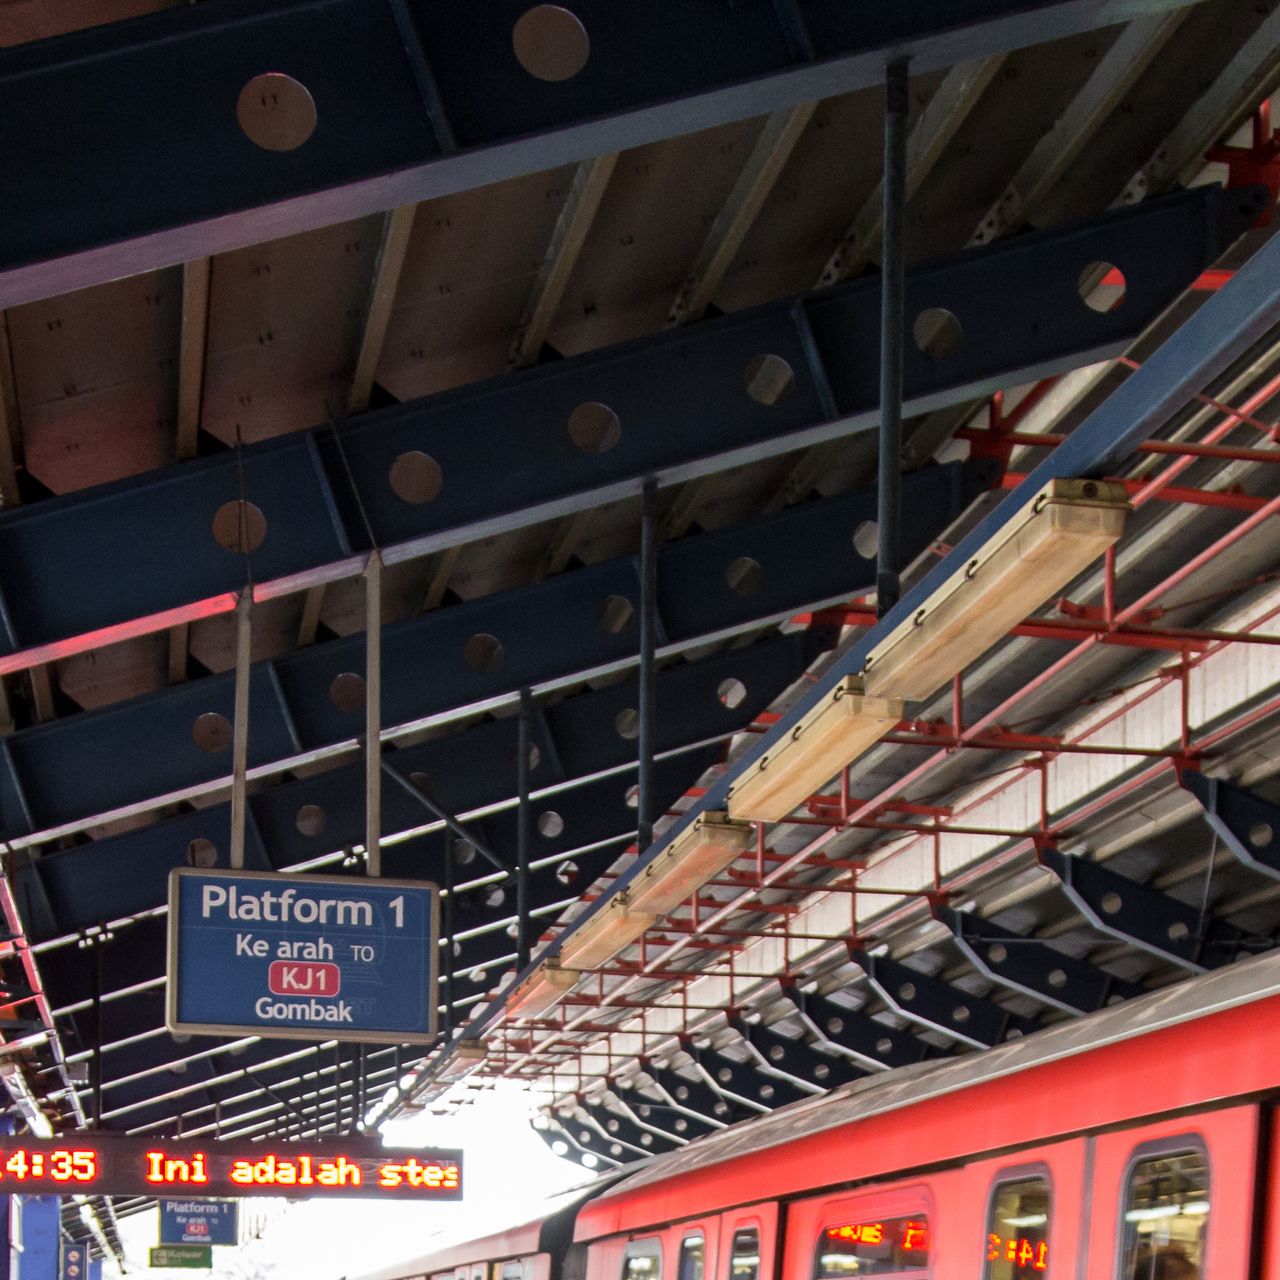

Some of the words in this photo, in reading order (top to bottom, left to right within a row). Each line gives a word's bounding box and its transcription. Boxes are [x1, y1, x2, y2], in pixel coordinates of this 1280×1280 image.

[202, 885, 373, 926] Platform
[389, 896, 405, 927] 1
[236, 934, 269, 957] Ke
[277, 937, 333, 960] arah
[350, 945, 375, 962] TO
[282, 966, 327, 991] KJ1
[255, 998, 353, 1022] Gombak
[146, 1152, 208, 1182] Ini
[231, 1155, 361, 1185] adalah
[166, 1201, 218, 1213] Platform
[222, 1203, 228, 1213] 1
